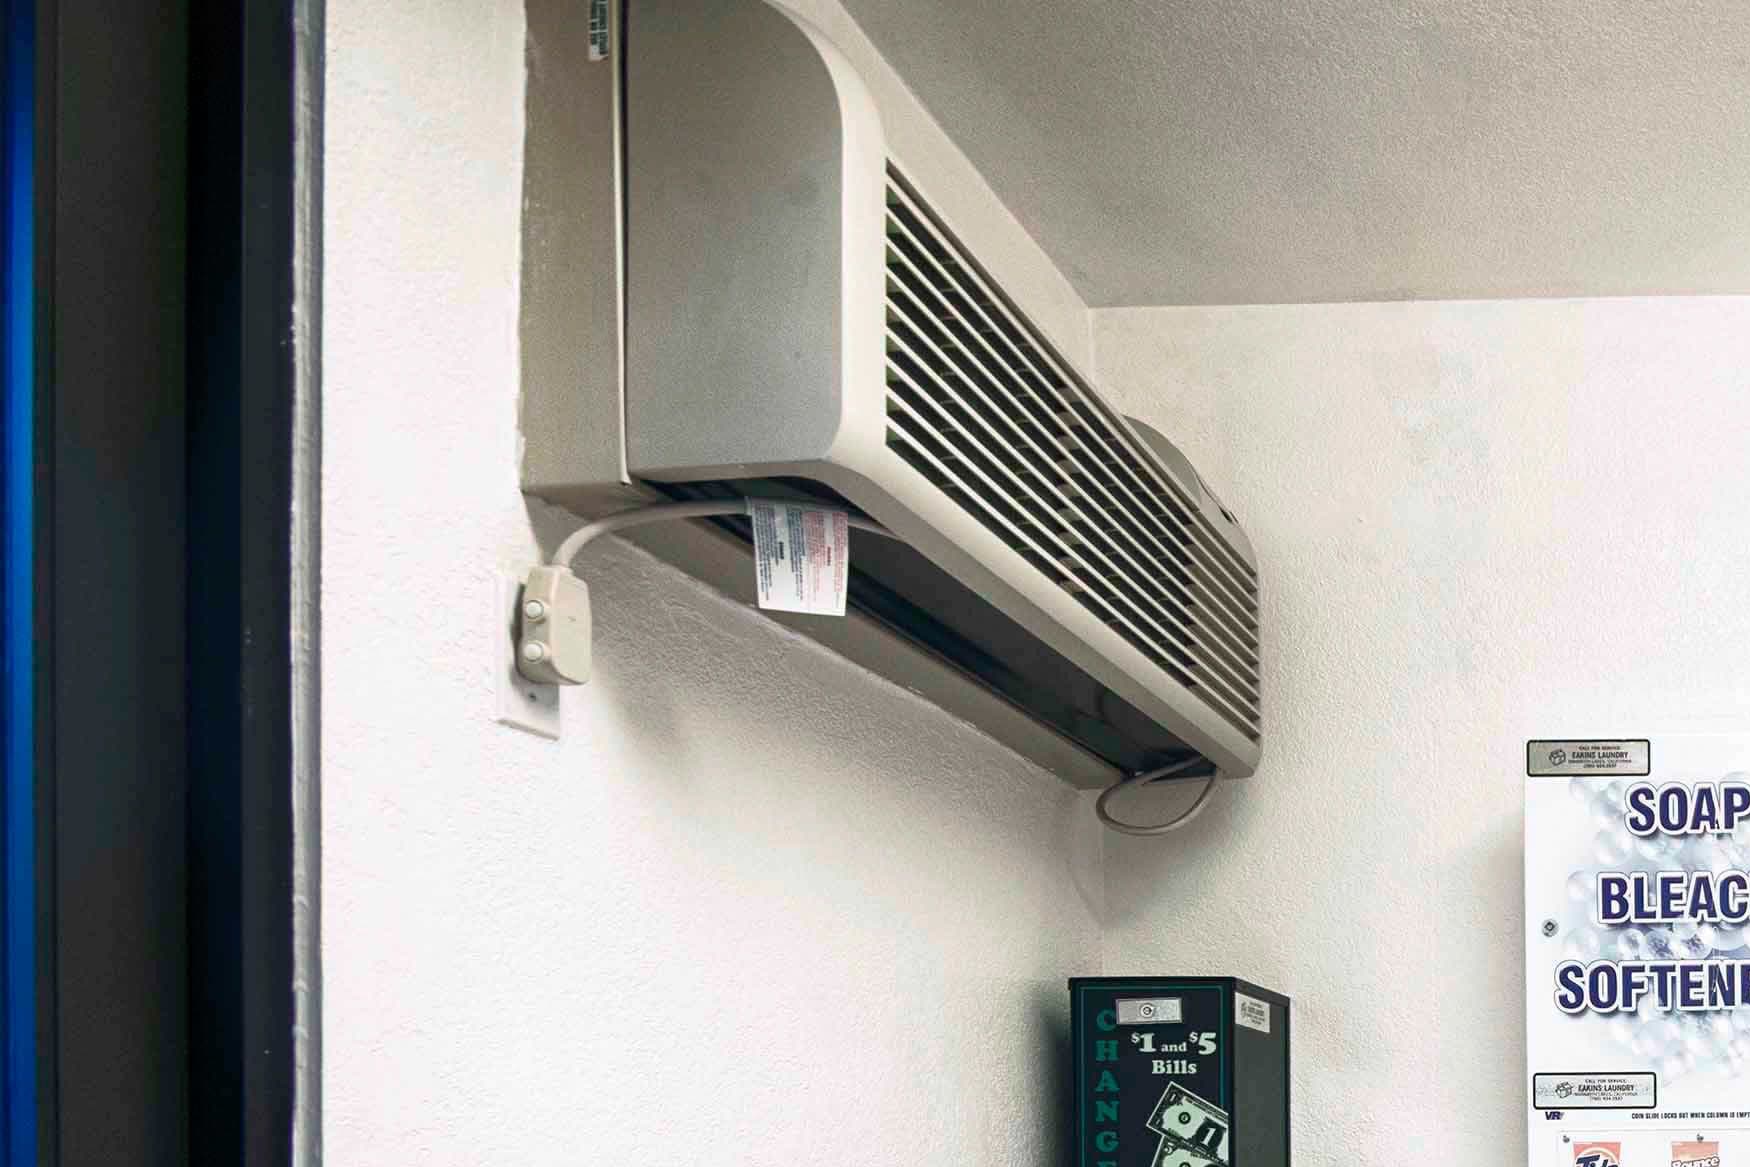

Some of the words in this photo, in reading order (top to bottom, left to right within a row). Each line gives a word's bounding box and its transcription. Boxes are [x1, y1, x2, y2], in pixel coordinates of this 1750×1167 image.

[1131, 1032, 1157, 1053] $1
[1161, 1042, 1188, 1053] and
[1189, 1032, 1217, 1055] $5
[1151, 1060, 1198, 1075] Bills
[1578, 1084, 1602, 1092] EAKINS
[1604, 1084, 1634, 1092] LAUNDRY
[1661, 1112, 1678, 1120] LOCKS
[1200, 1127, 1217, 1147] 1
